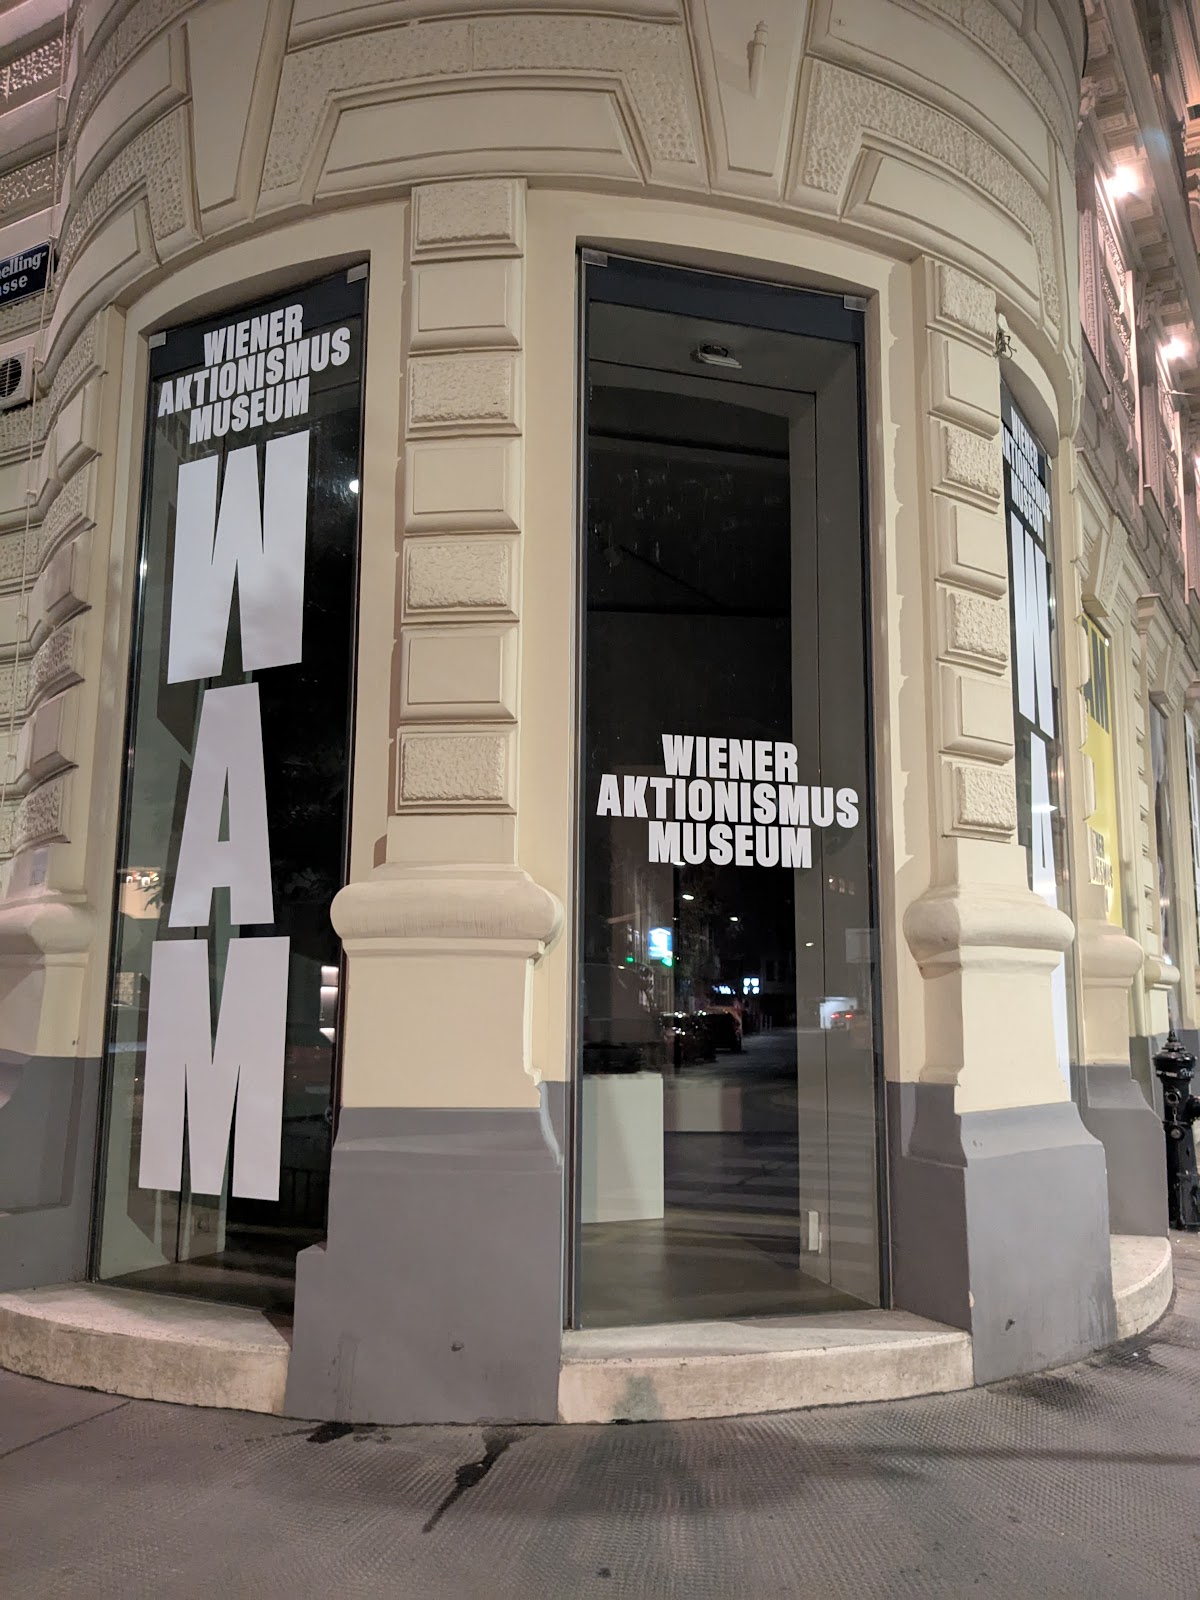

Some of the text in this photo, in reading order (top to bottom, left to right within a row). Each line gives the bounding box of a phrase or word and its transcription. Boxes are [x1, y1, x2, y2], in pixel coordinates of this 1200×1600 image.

[0, 252, 47, 280] elling-
[0, 275, 28, 296] sse
[204, 304, 304, 367] WIENER
[158, 327, 351, 418] AKTIONISMUS
[189, 376, 310, 444] MUSEUM
[1011, 405, 1039, 479] WIENER
[1010, 468, 1045, 543] MUSEUM
[661, 733, 798, 782] WIENER
[596, 773, 859, 828] AKTIONISMUS
[648, 820, 812, 868] MUSEUM
